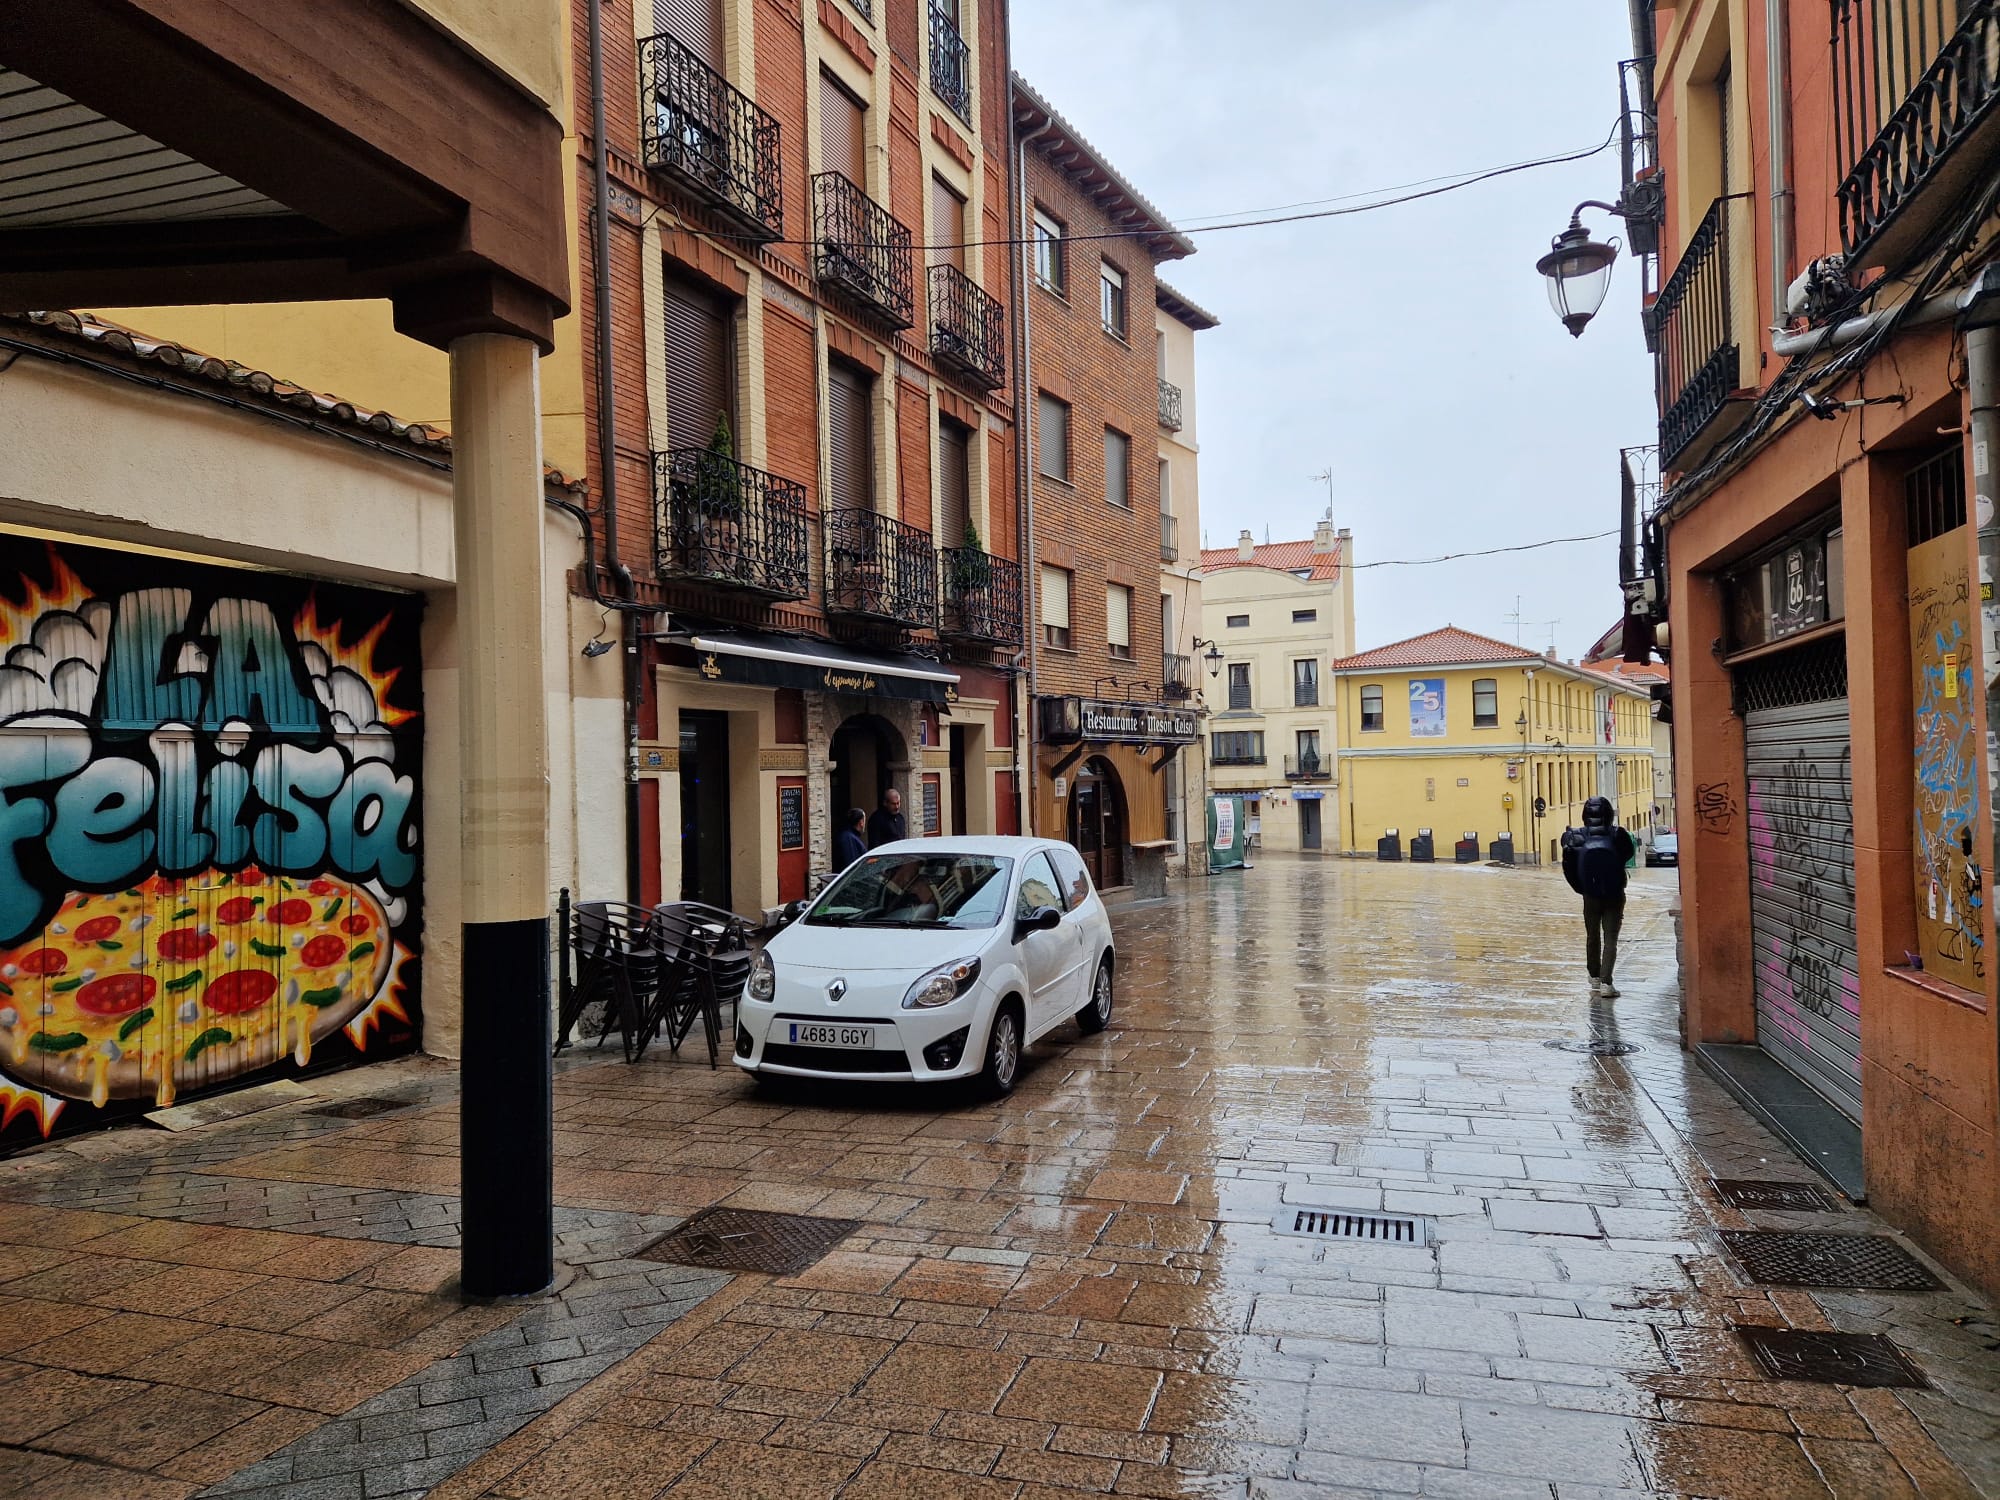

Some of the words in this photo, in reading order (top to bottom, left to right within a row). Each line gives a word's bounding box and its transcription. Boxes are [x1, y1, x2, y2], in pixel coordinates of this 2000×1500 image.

[1790, 574, 1804, 606] 66
[102, 587, 326, 733] LA
[1410, 681, 1440, 711] 25
[1087, 710, 1138, 731] Restaurante
[1147, 714, 1172, 734] Mesón
[1174, 717, 1193, 735] Celso
[0, 713, 418, 947] Felisa
[801, 1026, 836, 1043] 4683
[841, 1028, 868, 1045] GGY
